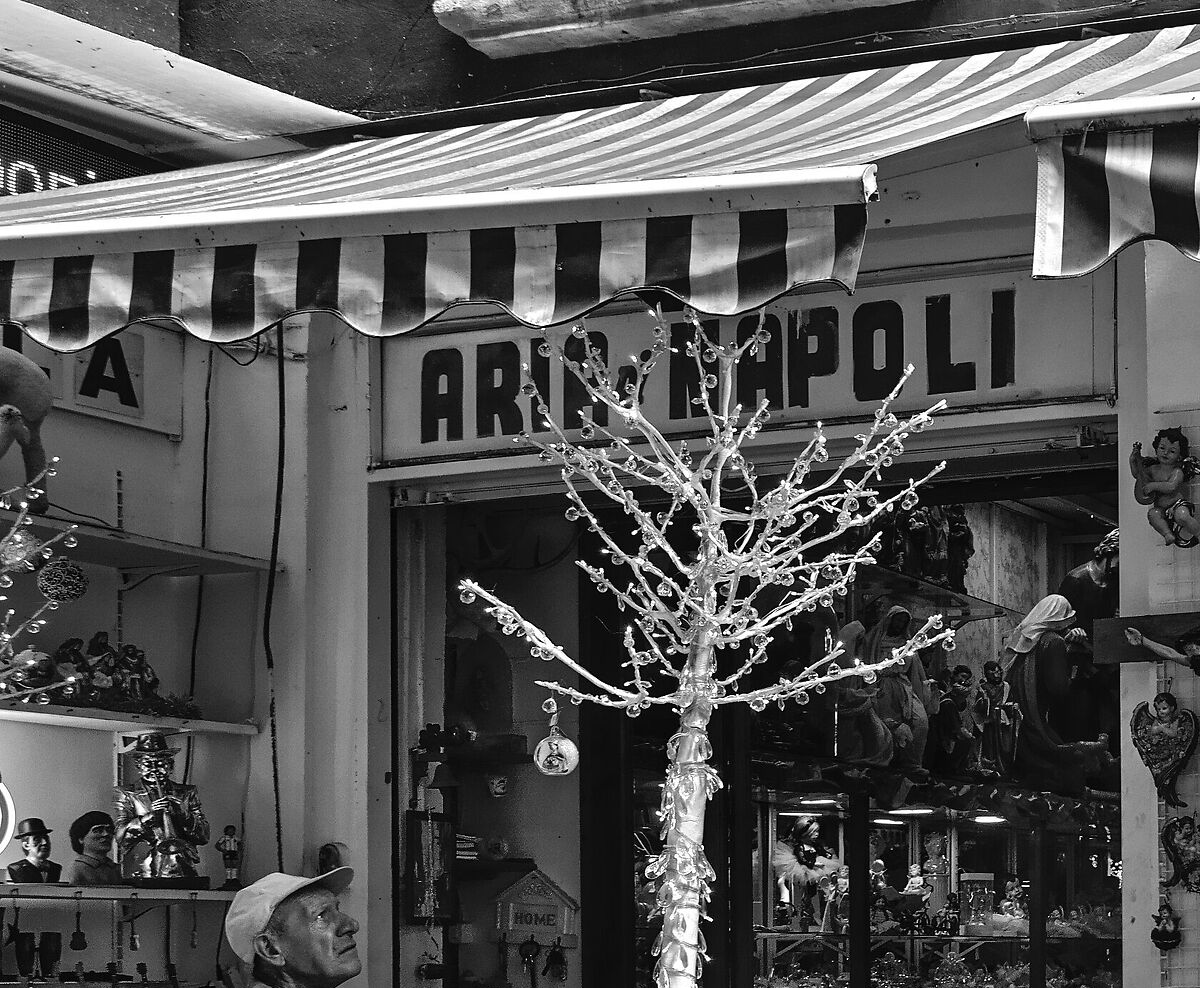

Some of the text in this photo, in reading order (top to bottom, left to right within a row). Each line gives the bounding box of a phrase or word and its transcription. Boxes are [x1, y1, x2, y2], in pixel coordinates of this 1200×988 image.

[421, 331, 608, 443] ARIA
[669, 289, 1015, 420] NAPOLI
[514, 912, 556, 926] HOME
